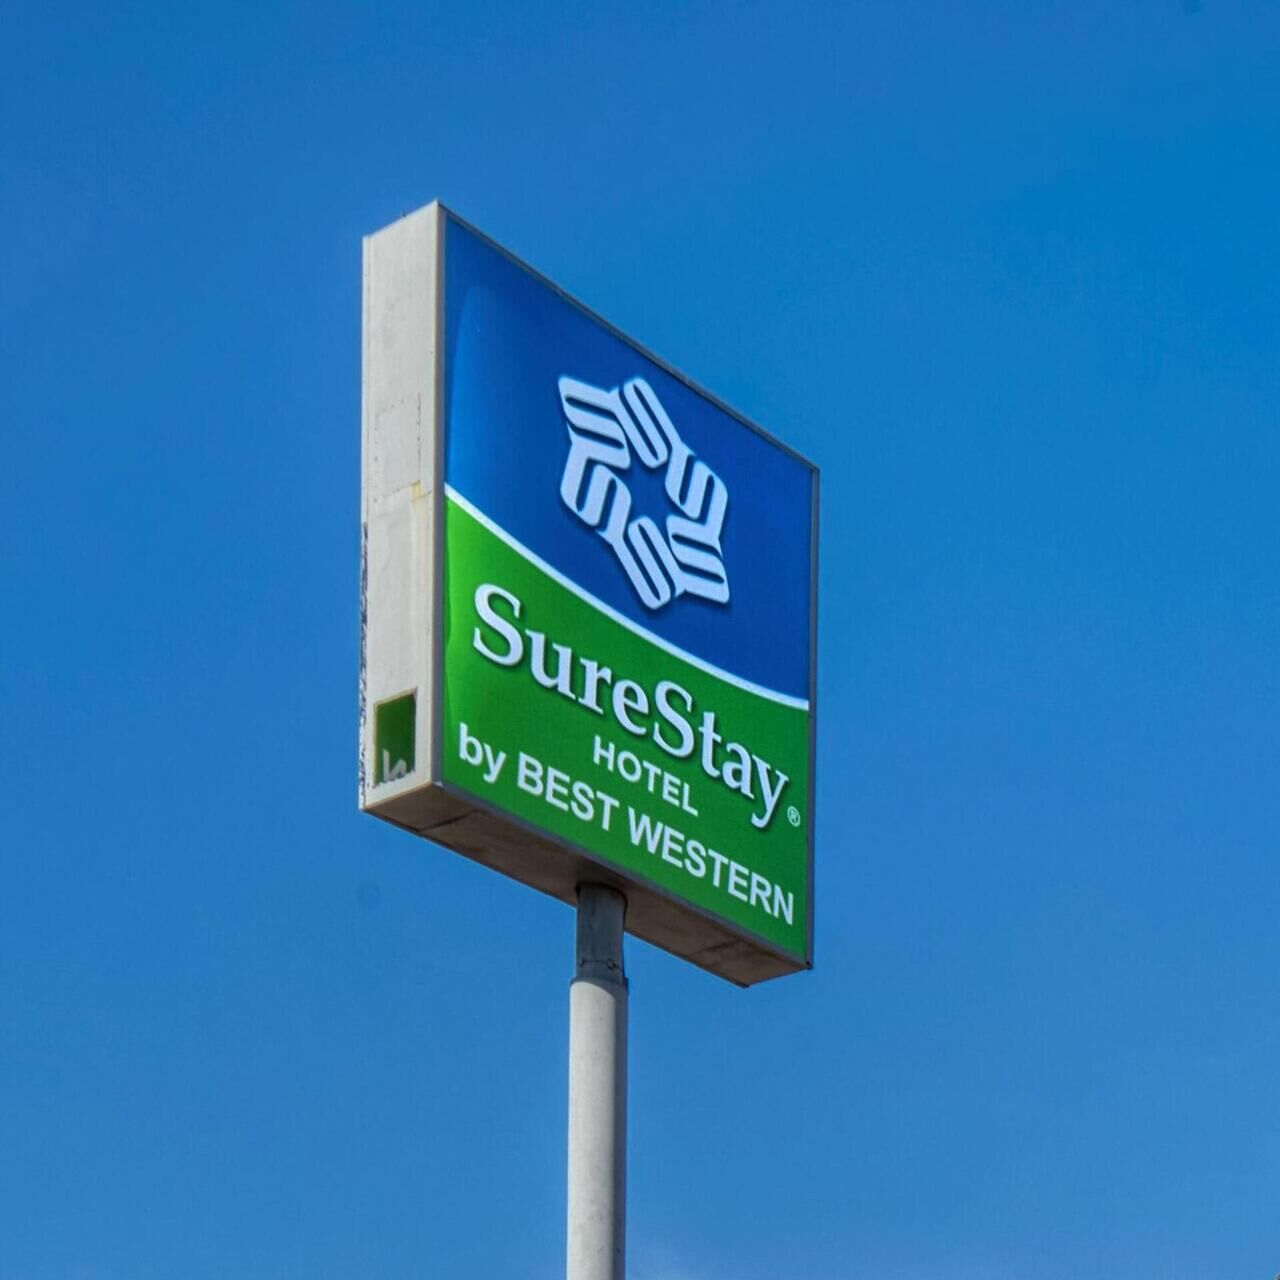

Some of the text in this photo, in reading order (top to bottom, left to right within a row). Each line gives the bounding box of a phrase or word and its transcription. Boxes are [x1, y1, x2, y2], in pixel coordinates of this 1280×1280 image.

[458, 721, 794, 926] by BEST WESTERN
[593, 734, 699, 817] HOTEL
